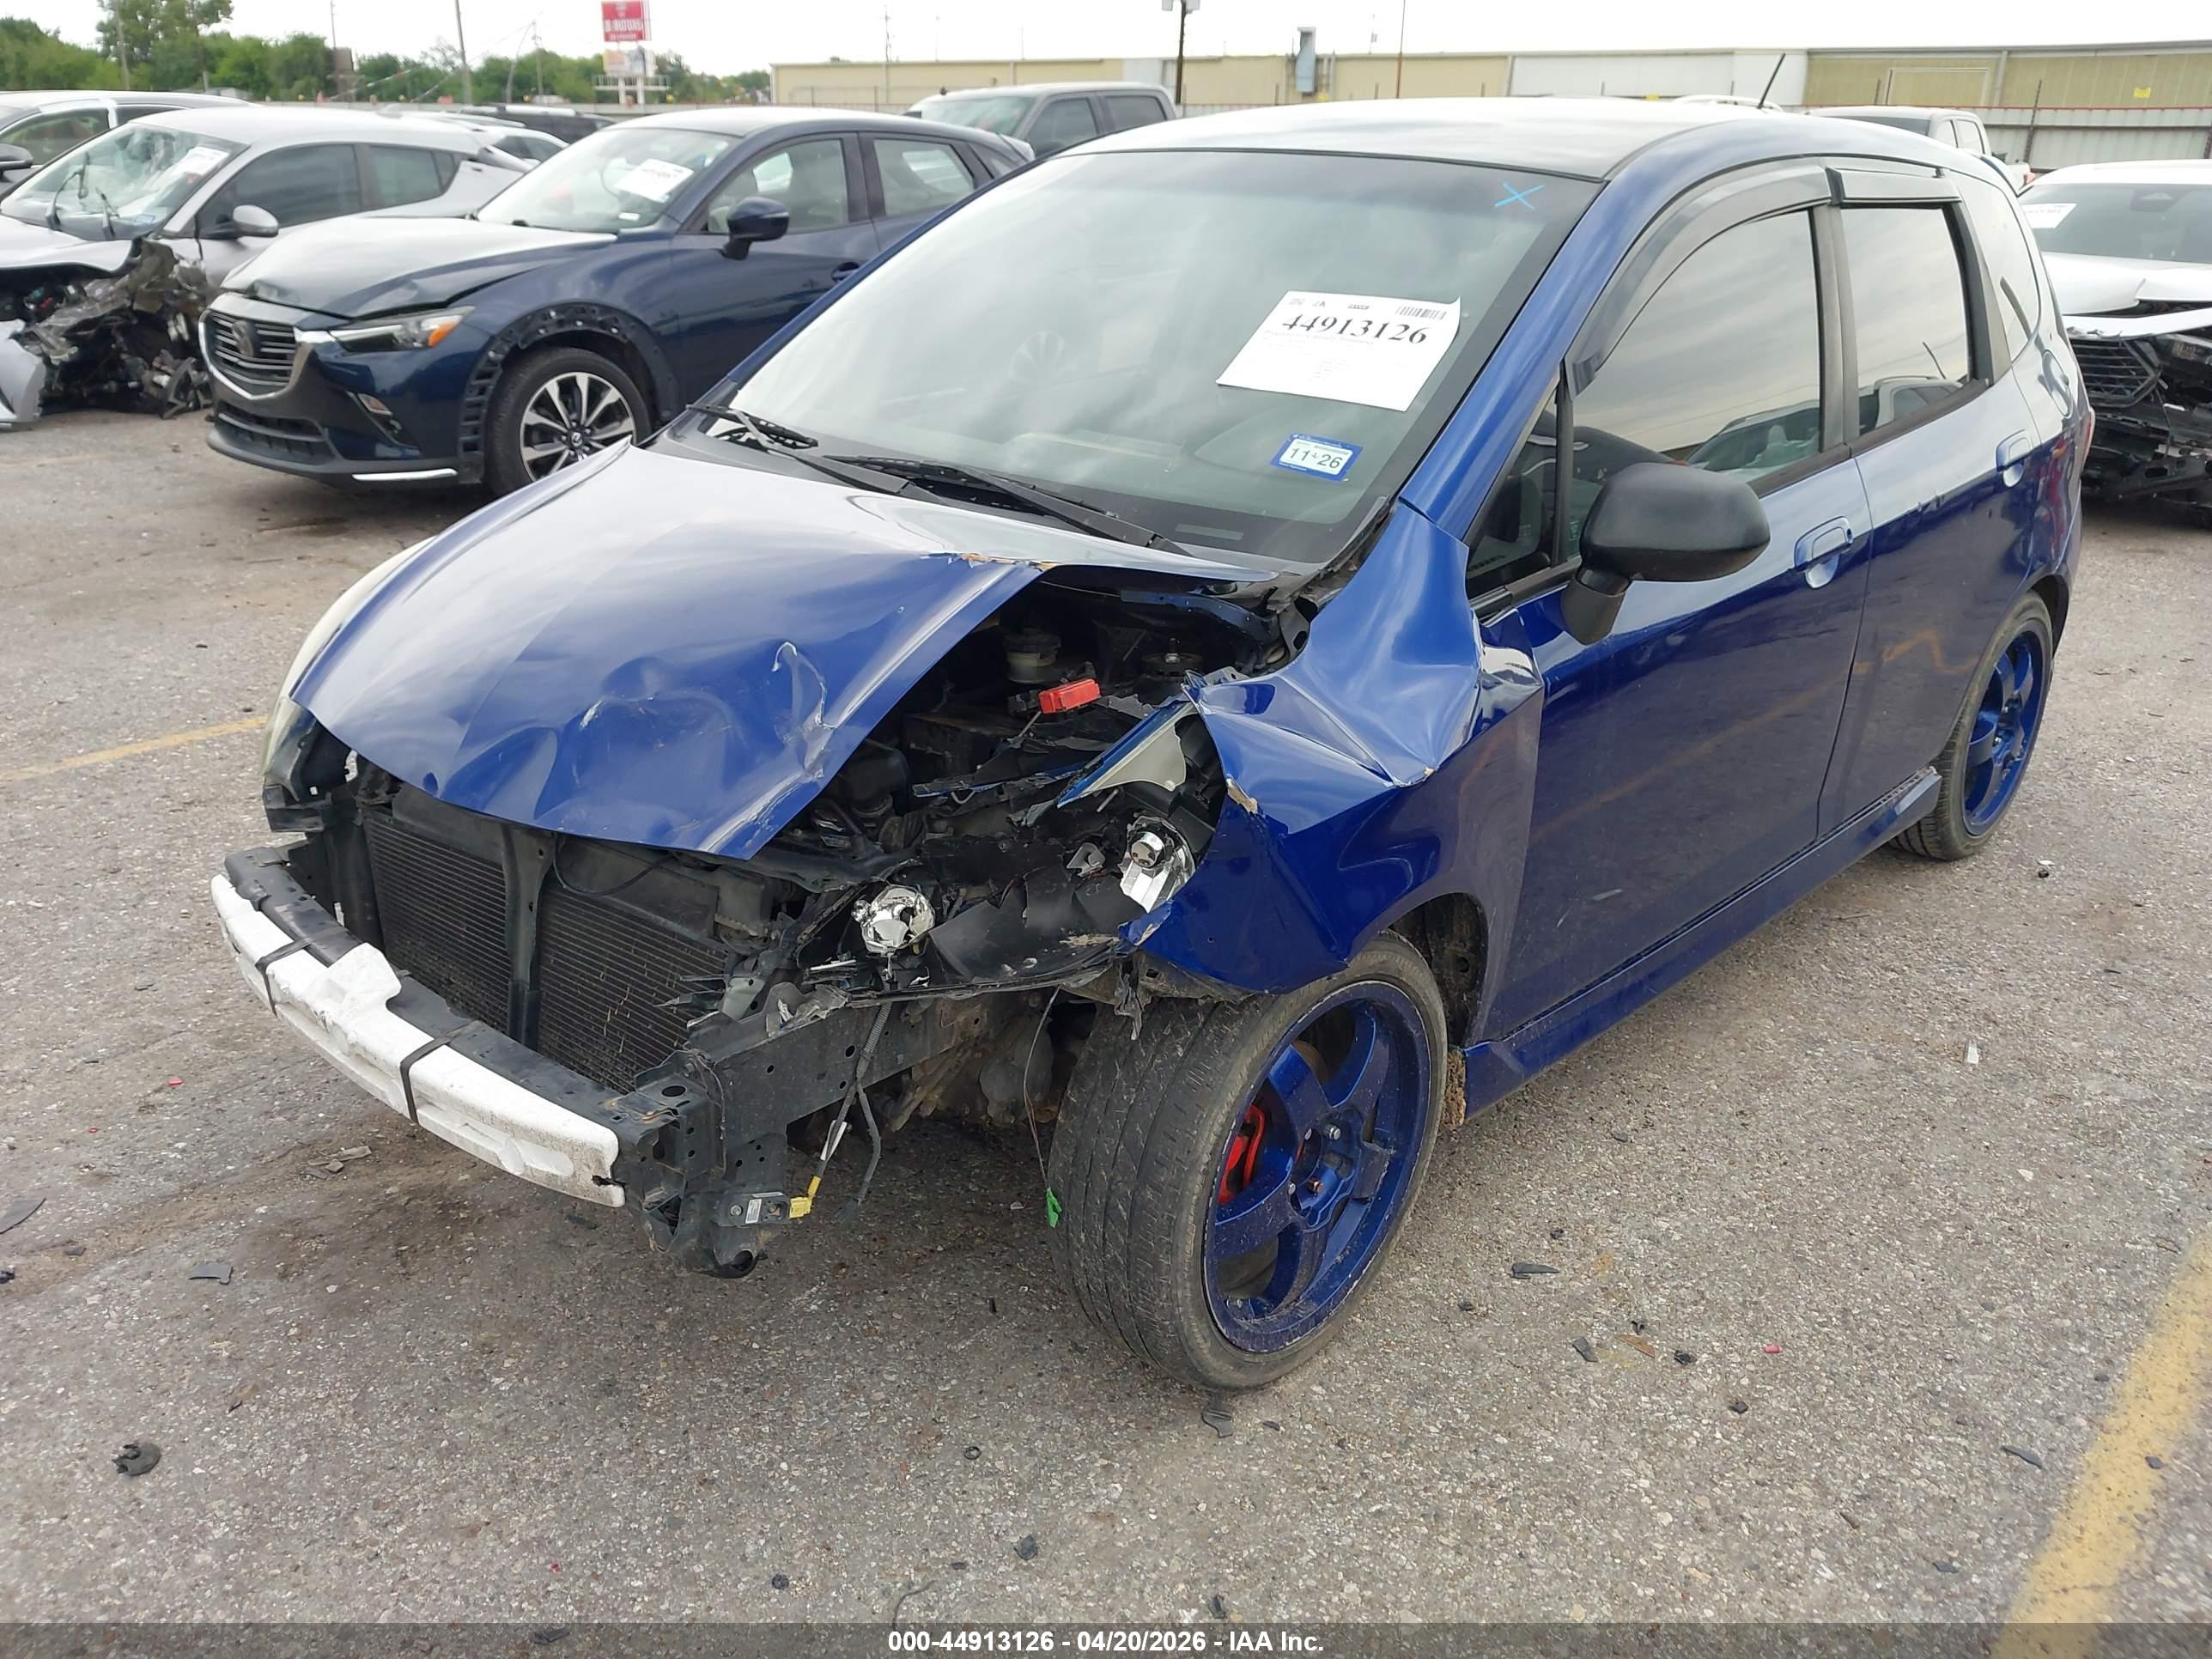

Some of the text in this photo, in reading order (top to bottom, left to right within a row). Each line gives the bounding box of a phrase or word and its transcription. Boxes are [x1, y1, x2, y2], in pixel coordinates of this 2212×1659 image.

[1282, 313, 1431, 344] 44913126
[1290, 447, 1310, 461] 11
[1316, 453, 1344, 469] 26
